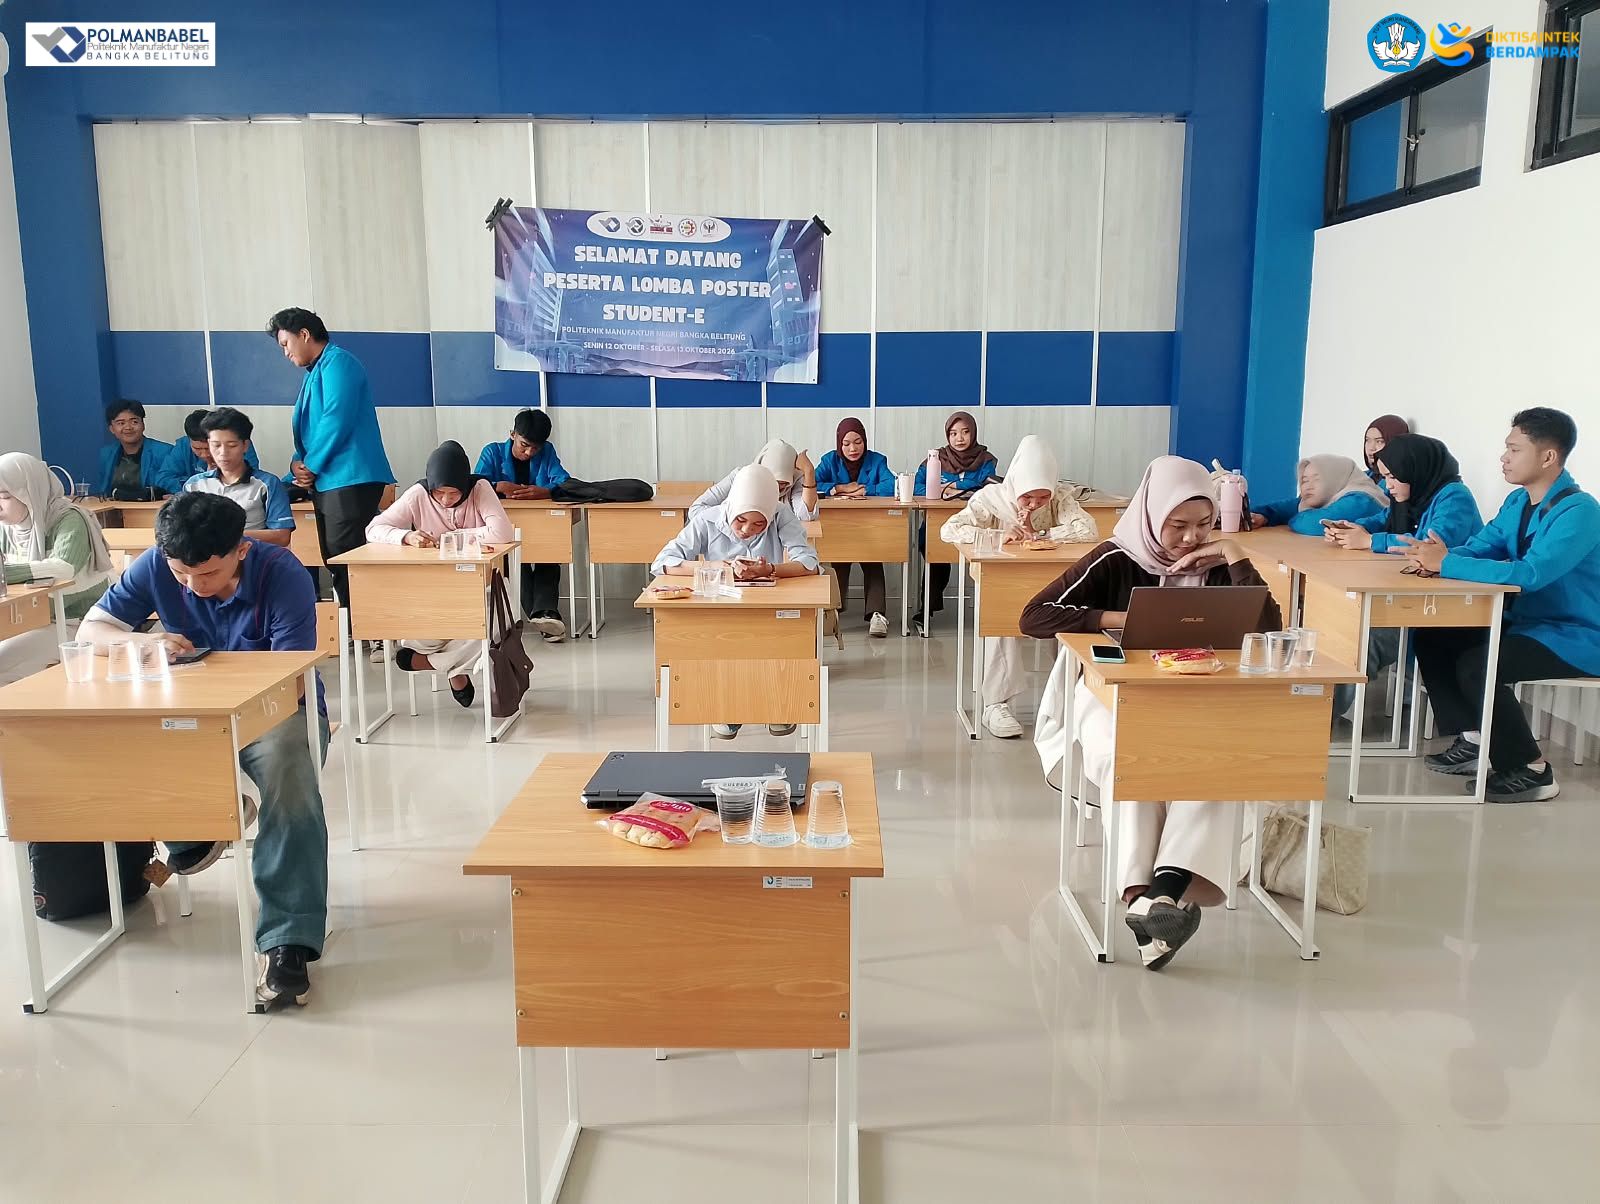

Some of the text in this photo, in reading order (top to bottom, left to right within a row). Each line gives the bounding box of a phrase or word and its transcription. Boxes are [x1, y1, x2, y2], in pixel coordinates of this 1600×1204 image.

[575, 245, 742, 269] SELAMAT DATANG
[543, 272, 771, 298] PESERTA LOMBA POSTER
[603, 303, 705, 324] STUDENT-E
[561, 326, 604, 334] POLITEKNIK
[605, 329, 655, 337] MANUFAKTUR
[679, 331, 710, 340] BANGKA
[710, 333, 746, 341] BELITUNG
[583, 341, 604, 349] SENIN
[613, 343, 645, 351] OKTOBER
[686, 346, 716, 354] OKTOBER
[717, 347, 736, 355] 2026
